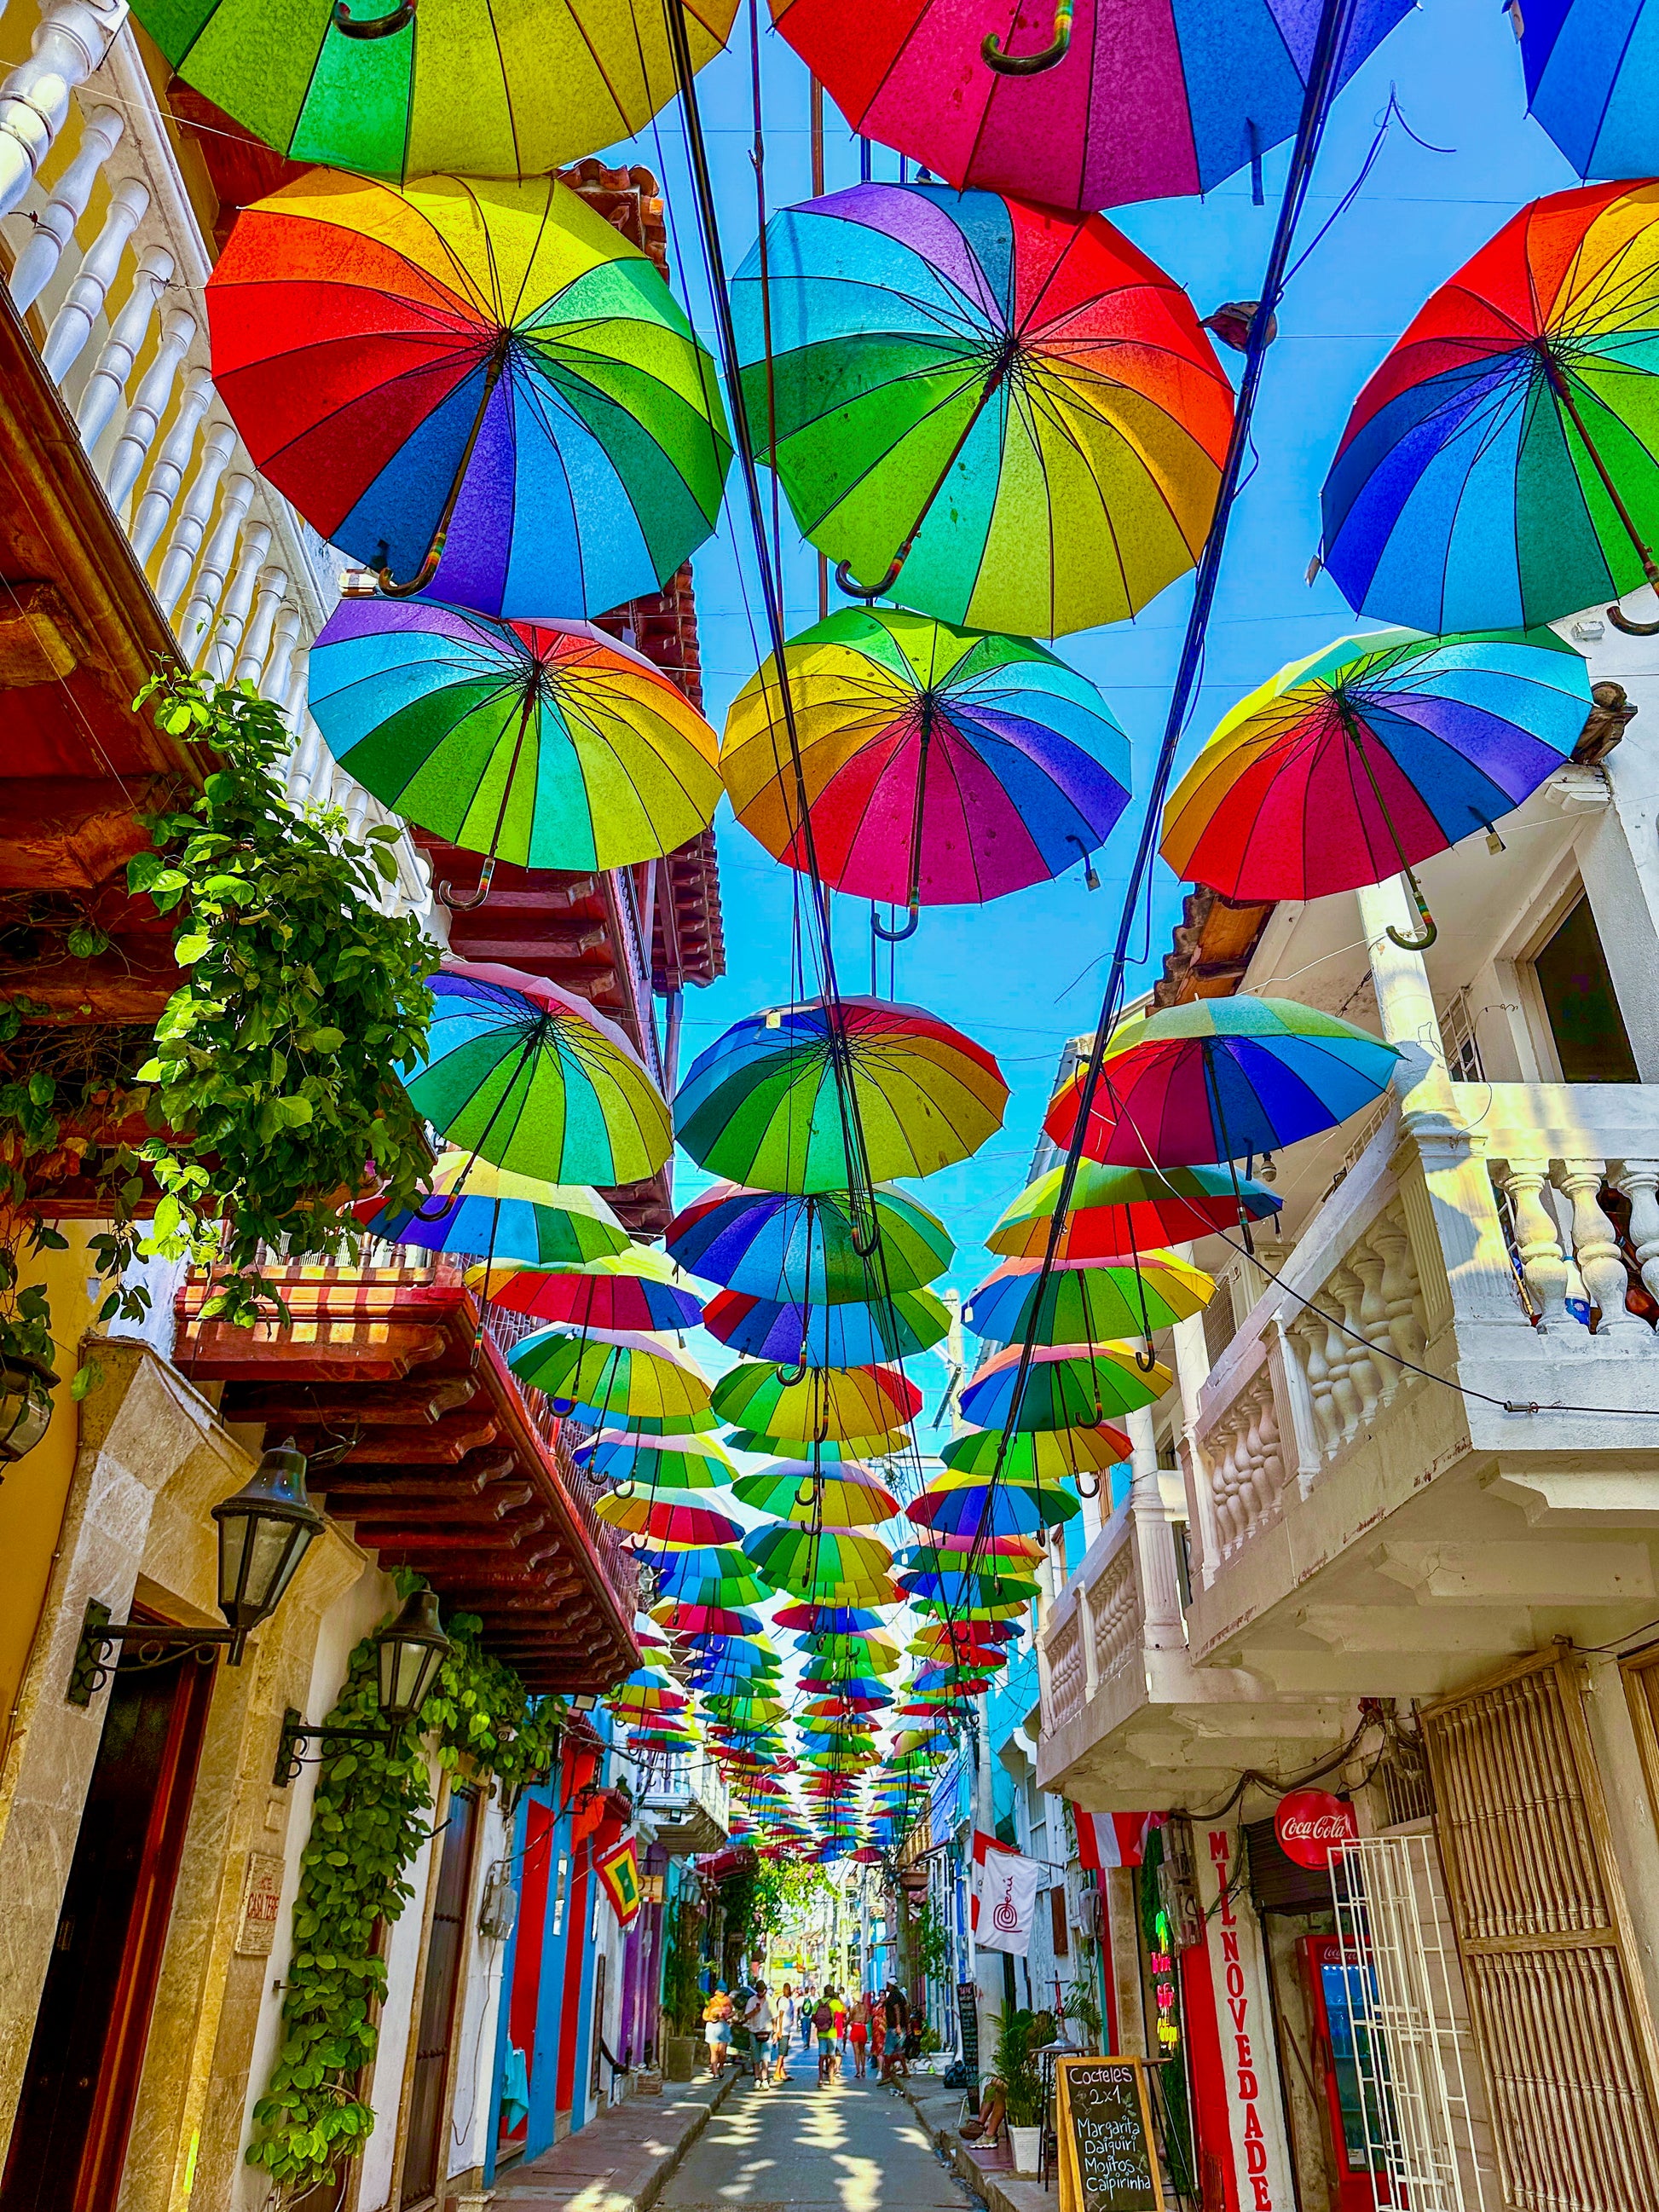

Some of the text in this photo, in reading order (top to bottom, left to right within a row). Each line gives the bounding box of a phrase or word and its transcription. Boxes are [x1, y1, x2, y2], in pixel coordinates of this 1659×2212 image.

[1281, 1814, 1345, 1840] Coca-Cola
[1209, 1831, 1272, 2212] MIL NOVEDADE
[1070, 2067, 1132, 2085] Cocteles
[1090, 2085, 1121, 2105] 2x1
[1078, 2115, 1140, 2140] Margarita
[1084, 2134, 1136, 2157] Daiquiri
[1084, 2155, 1136, 2177] Mojitos
[1086, 2172, 1151, 2201] Caipirinha
